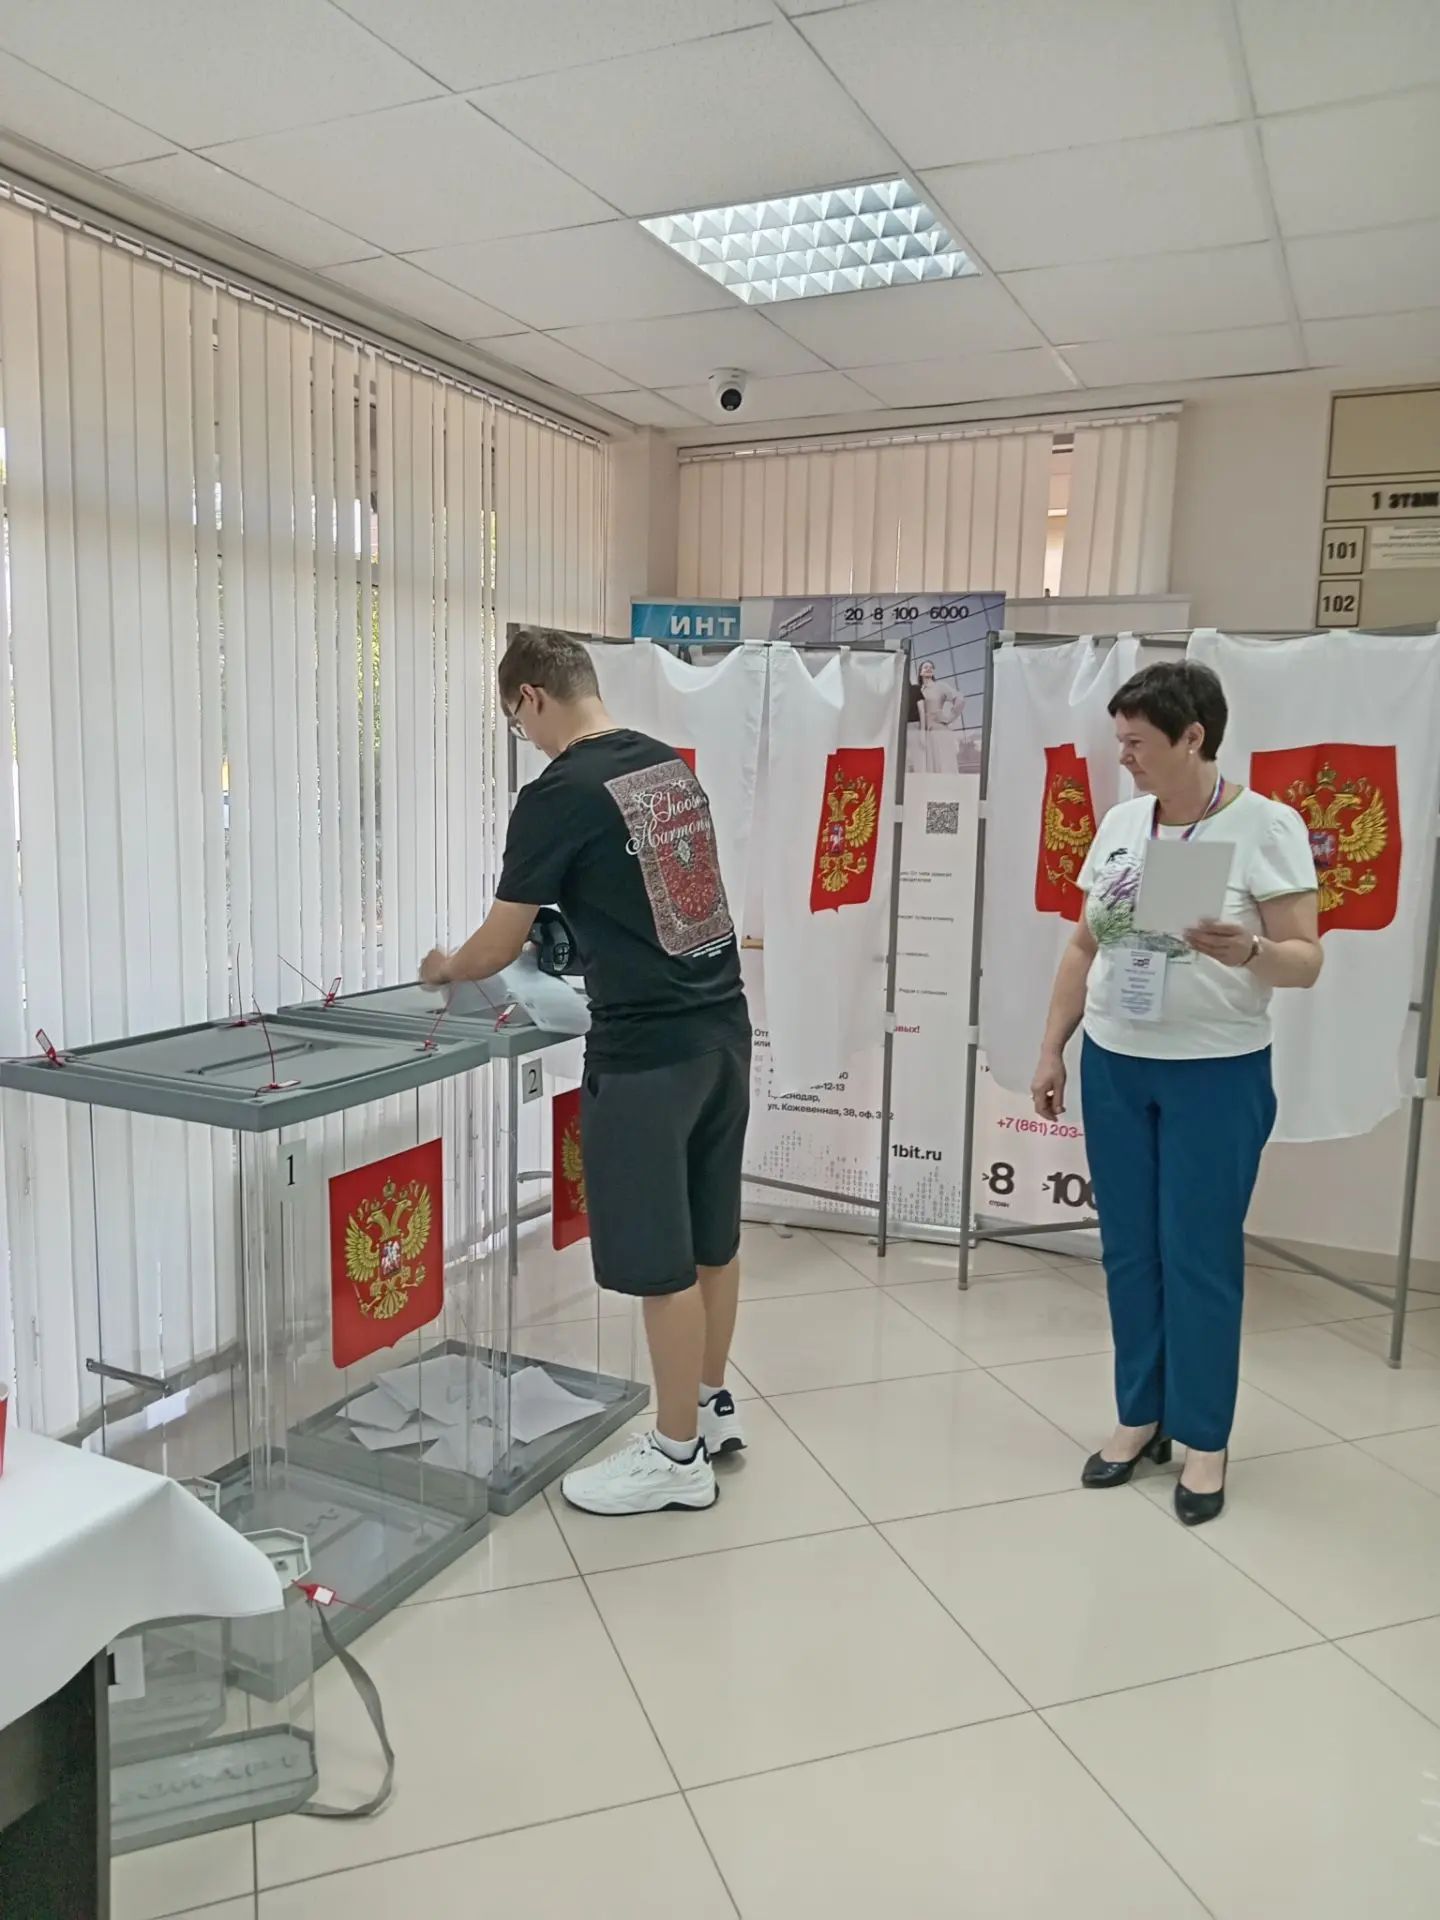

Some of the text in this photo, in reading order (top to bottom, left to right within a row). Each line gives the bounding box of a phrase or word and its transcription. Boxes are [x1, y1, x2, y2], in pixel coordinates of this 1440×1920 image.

[1372, 492, 1382, 510] 1
[1327, 542, 1356, 560] 101
[1323, 595, 1354, 613] 102
[527, 1068, 538, 1094] 2
[875, 1111, 894, 1120] 32
[997, 1117, 1015, 1129] +7
[1015, 1119, 1048, 1136] (861)
[892, 1144, 943, 1162] 1bit.ru
[286, 1154, 296, 1186] 1
